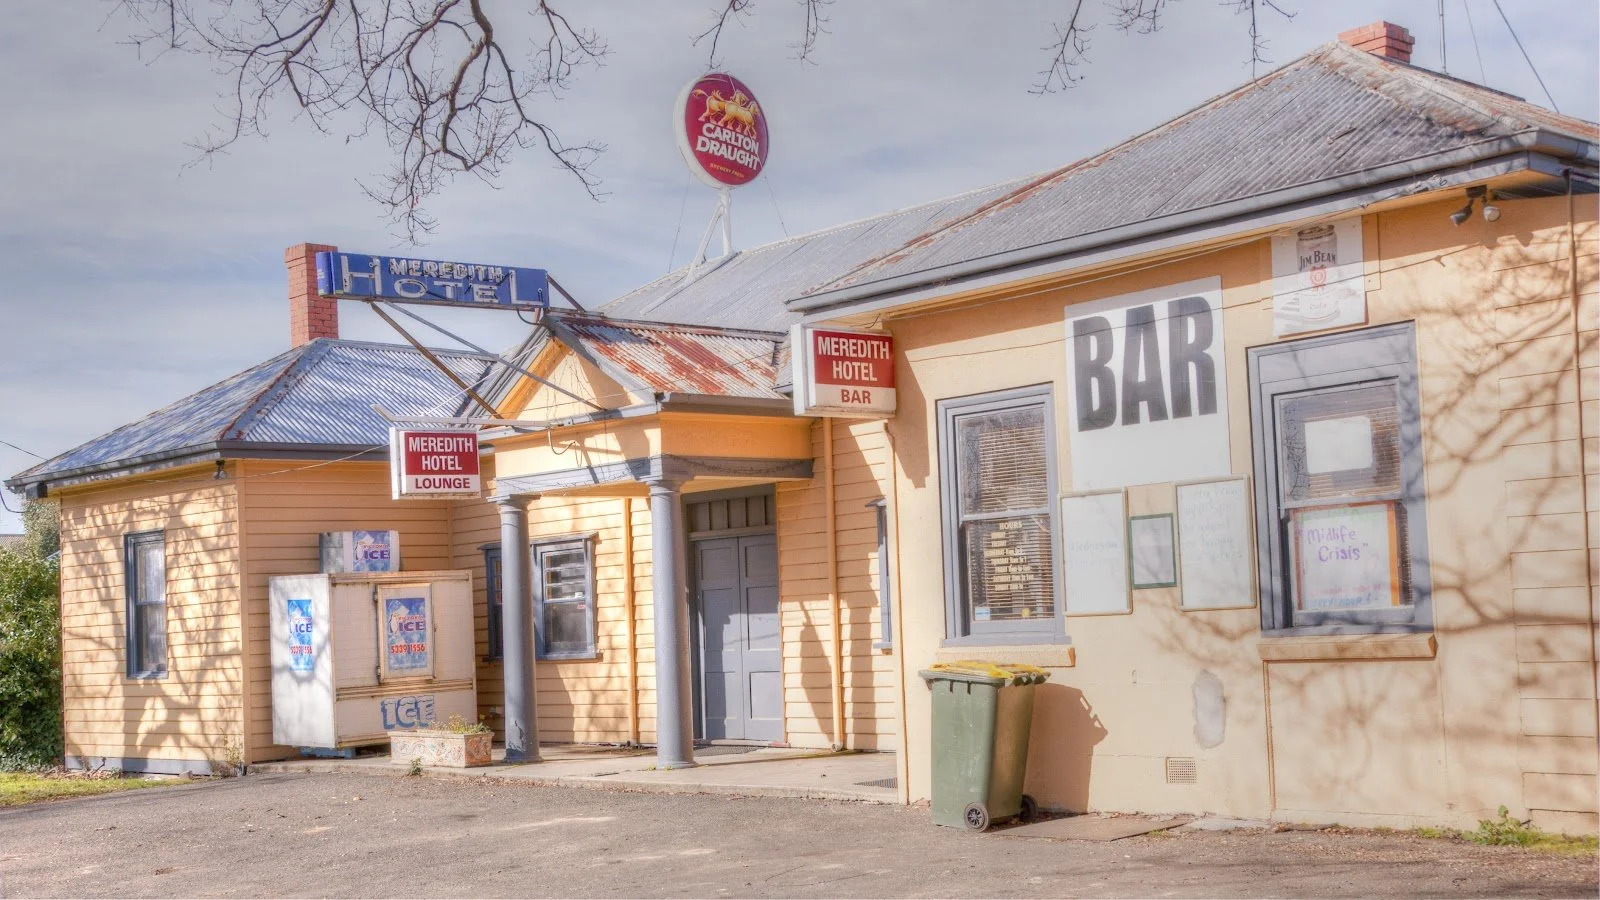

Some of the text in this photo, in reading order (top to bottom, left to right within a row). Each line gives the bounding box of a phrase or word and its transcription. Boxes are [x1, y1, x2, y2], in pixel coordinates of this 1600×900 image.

[702, 122, 759, 154] CARLTON
[696, 136, 760, 170] DRAUGHT
[389, 258, 504, 282] MEREDITH
[1300, 255, 1312, 271] JIM
[341, 256, 543, 306] HOTEL
[818, 336, 890, 360] MEREDITH
[832, 360, 878, 381] HOTEL
[1073, 296, 1217, 432] BAR
[841, 389, 872, 404] BAR
[408, 436, 474, 453] MEREDITH
[421, 455, 463, 471] HOTEL
[415, 477, 471, 489] LOUNGE
[364, 549, 389, 560] ICE
[295, 623, 312, 633] ICE
[398, 621, 425, 632] ICE
[381, 695, 436, 730] ICE
